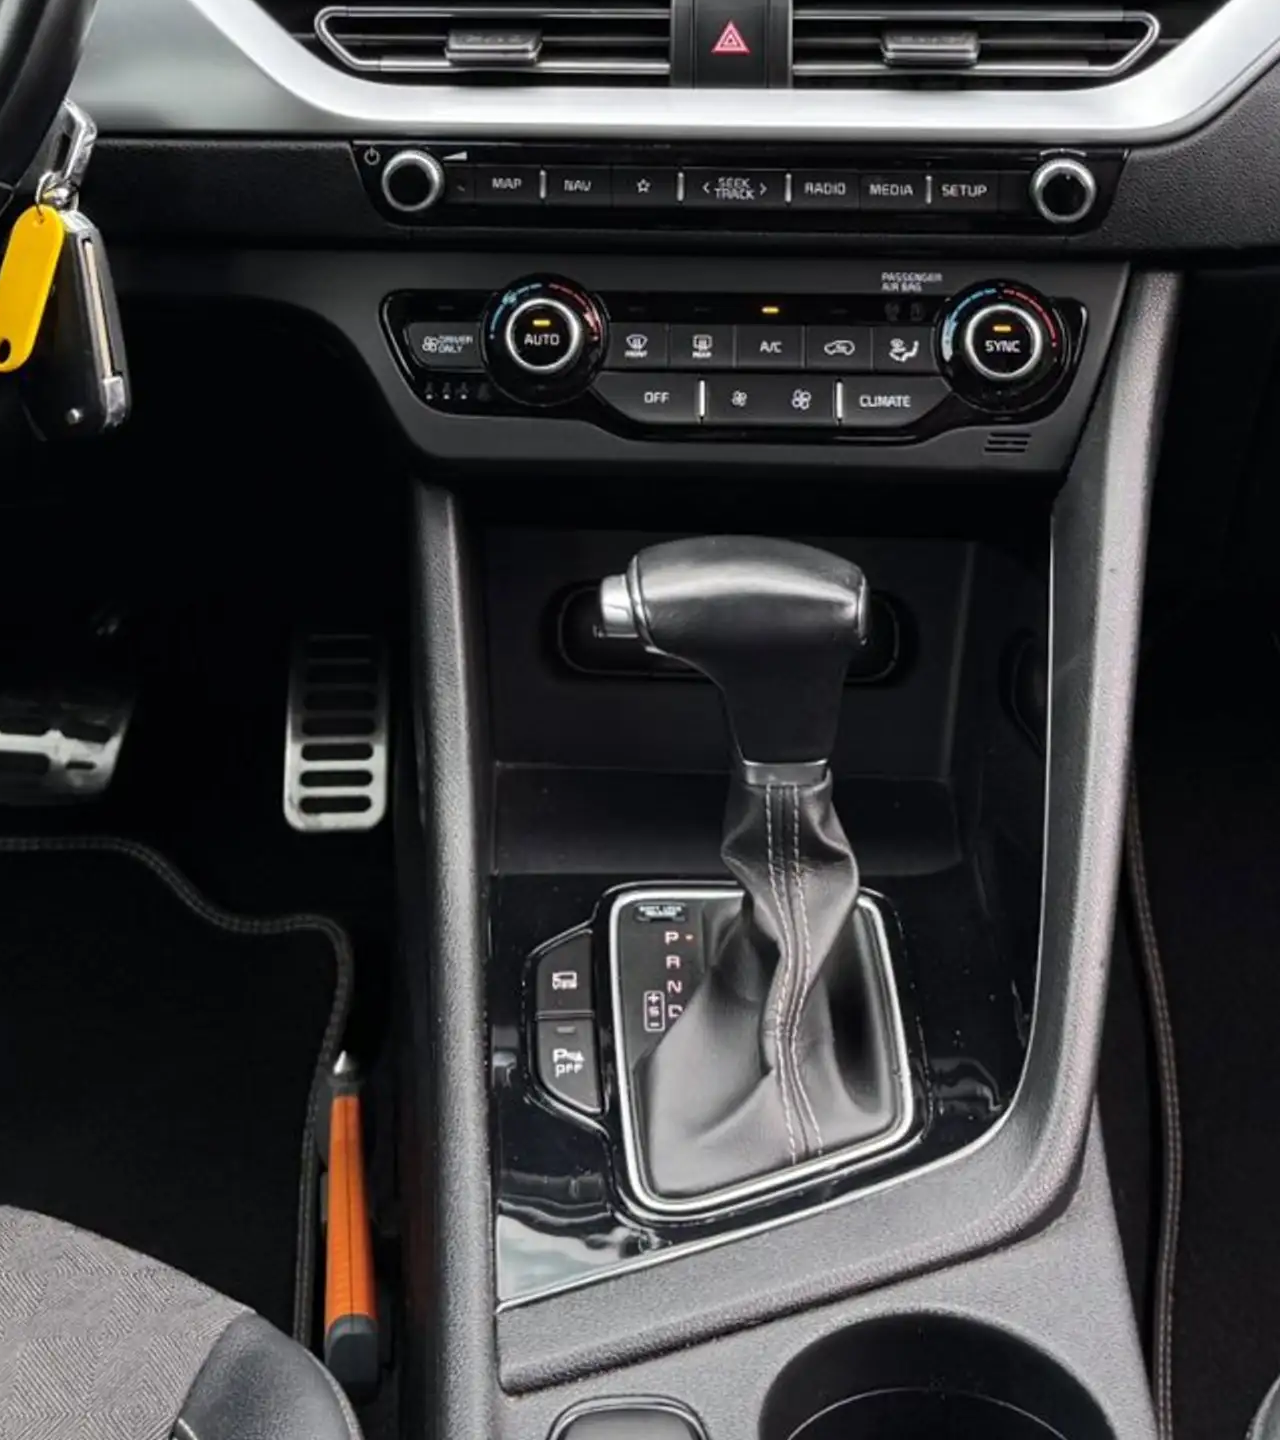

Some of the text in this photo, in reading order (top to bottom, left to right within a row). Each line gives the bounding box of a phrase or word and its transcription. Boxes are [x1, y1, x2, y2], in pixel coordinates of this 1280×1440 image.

[492, 177, 522, 190] MAP
[564, 179, 592, 192] NAV
[718, 177, 750, 188] SEEK
[804, 181, 847, 196] RADIO
[715, 187, 755, 200] TRACK
[869, 183, 914, 197] MEDIA
[941, 184, 988, 198] SETUP
[881, 271, 943, 282] PASSENGER
[523, 334, 561, 347] AUTO
[760, 340, 782, 354] A/C
[984, 339, 1021, 353] SYNC
[643, 391, 670, 404] OFF
[859, 394, 912, 408] CLIMATE
[665, 932, 679, 944] P
[666, 956, 680, 969] R
[667, 980, 682, 993] N
